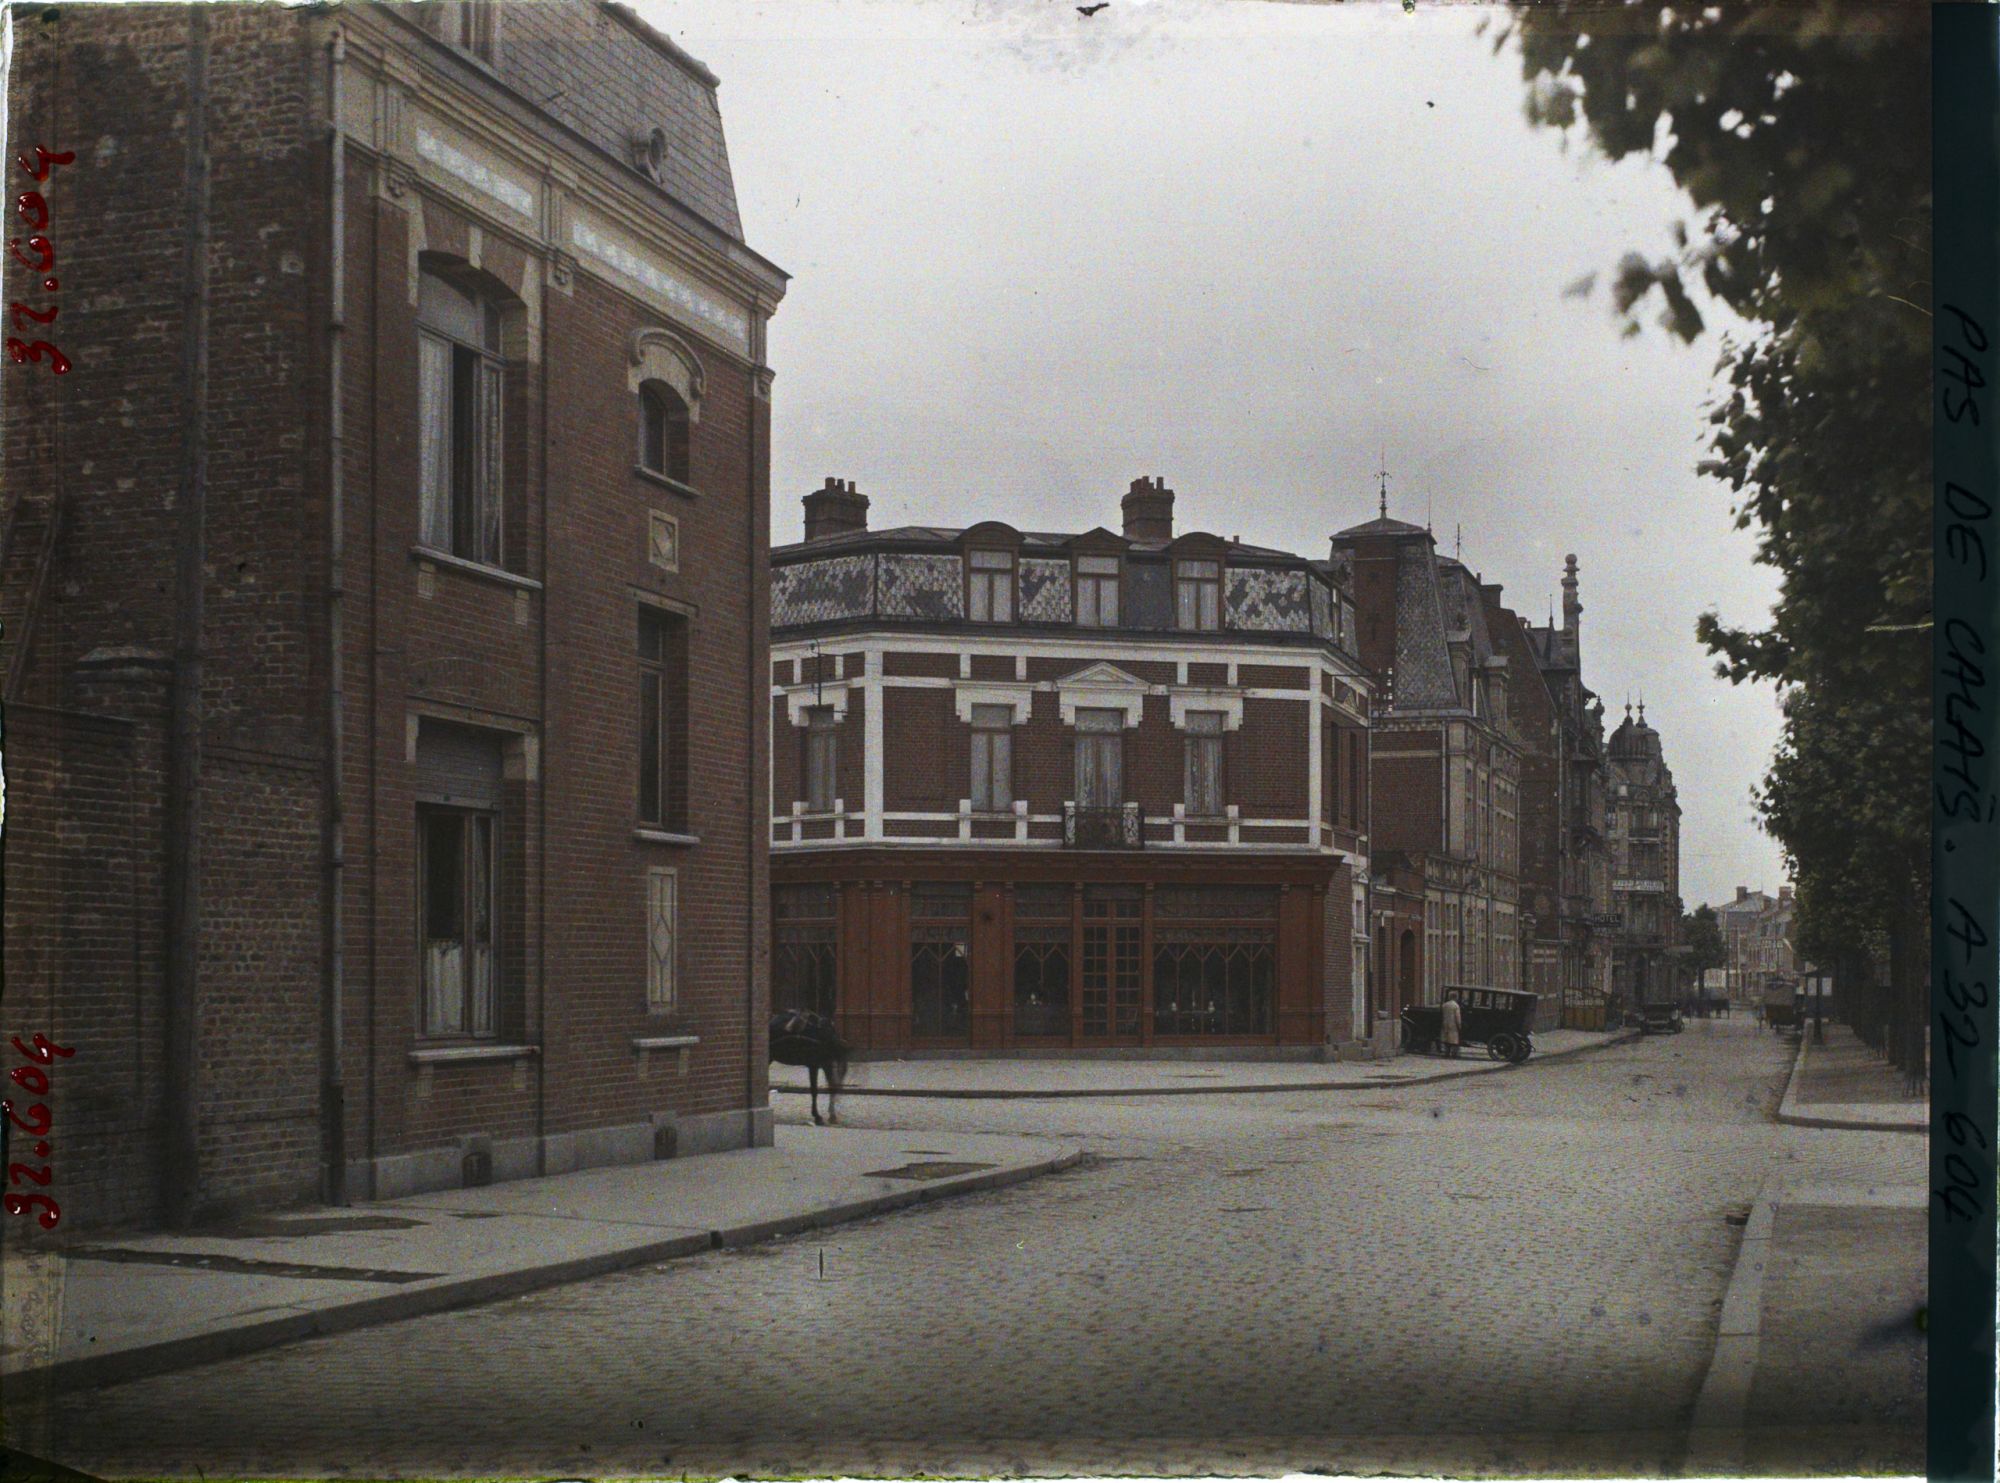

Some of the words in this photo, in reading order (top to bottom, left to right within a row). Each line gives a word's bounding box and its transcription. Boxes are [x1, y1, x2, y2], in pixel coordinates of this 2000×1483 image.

[1942, 303, 1990, 428] PAS
[1945, 481, 1993, 582] DE
[1594, 914, 1620, 923] HOTEL
[2, 1033, 76, 1230] 32.604
[1934, 1110, 1987, 1223] 604
